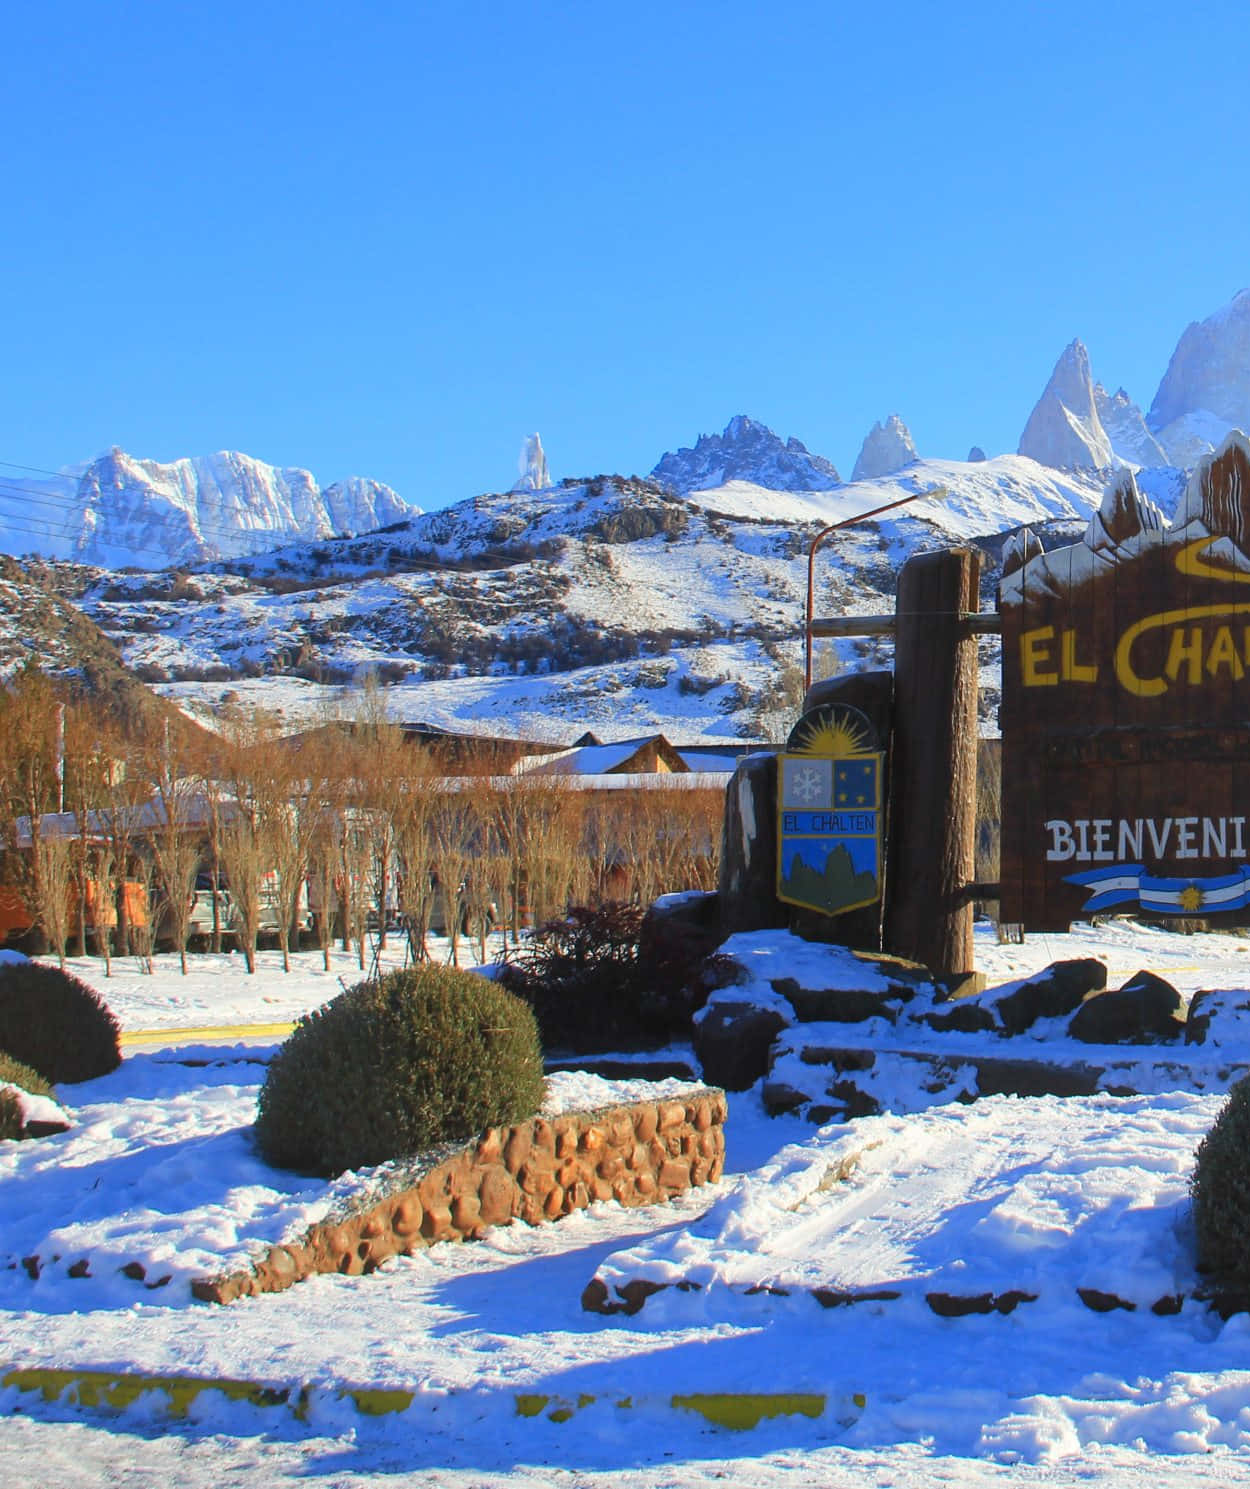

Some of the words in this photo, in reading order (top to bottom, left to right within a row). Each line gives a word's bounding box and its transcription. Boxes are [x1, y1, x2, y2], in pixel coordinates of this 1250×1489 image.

[1019, 626, 1098, 687] EL
[783, 815, 800, 832] EL
[812, 815, 874, 832] CHALTEN
